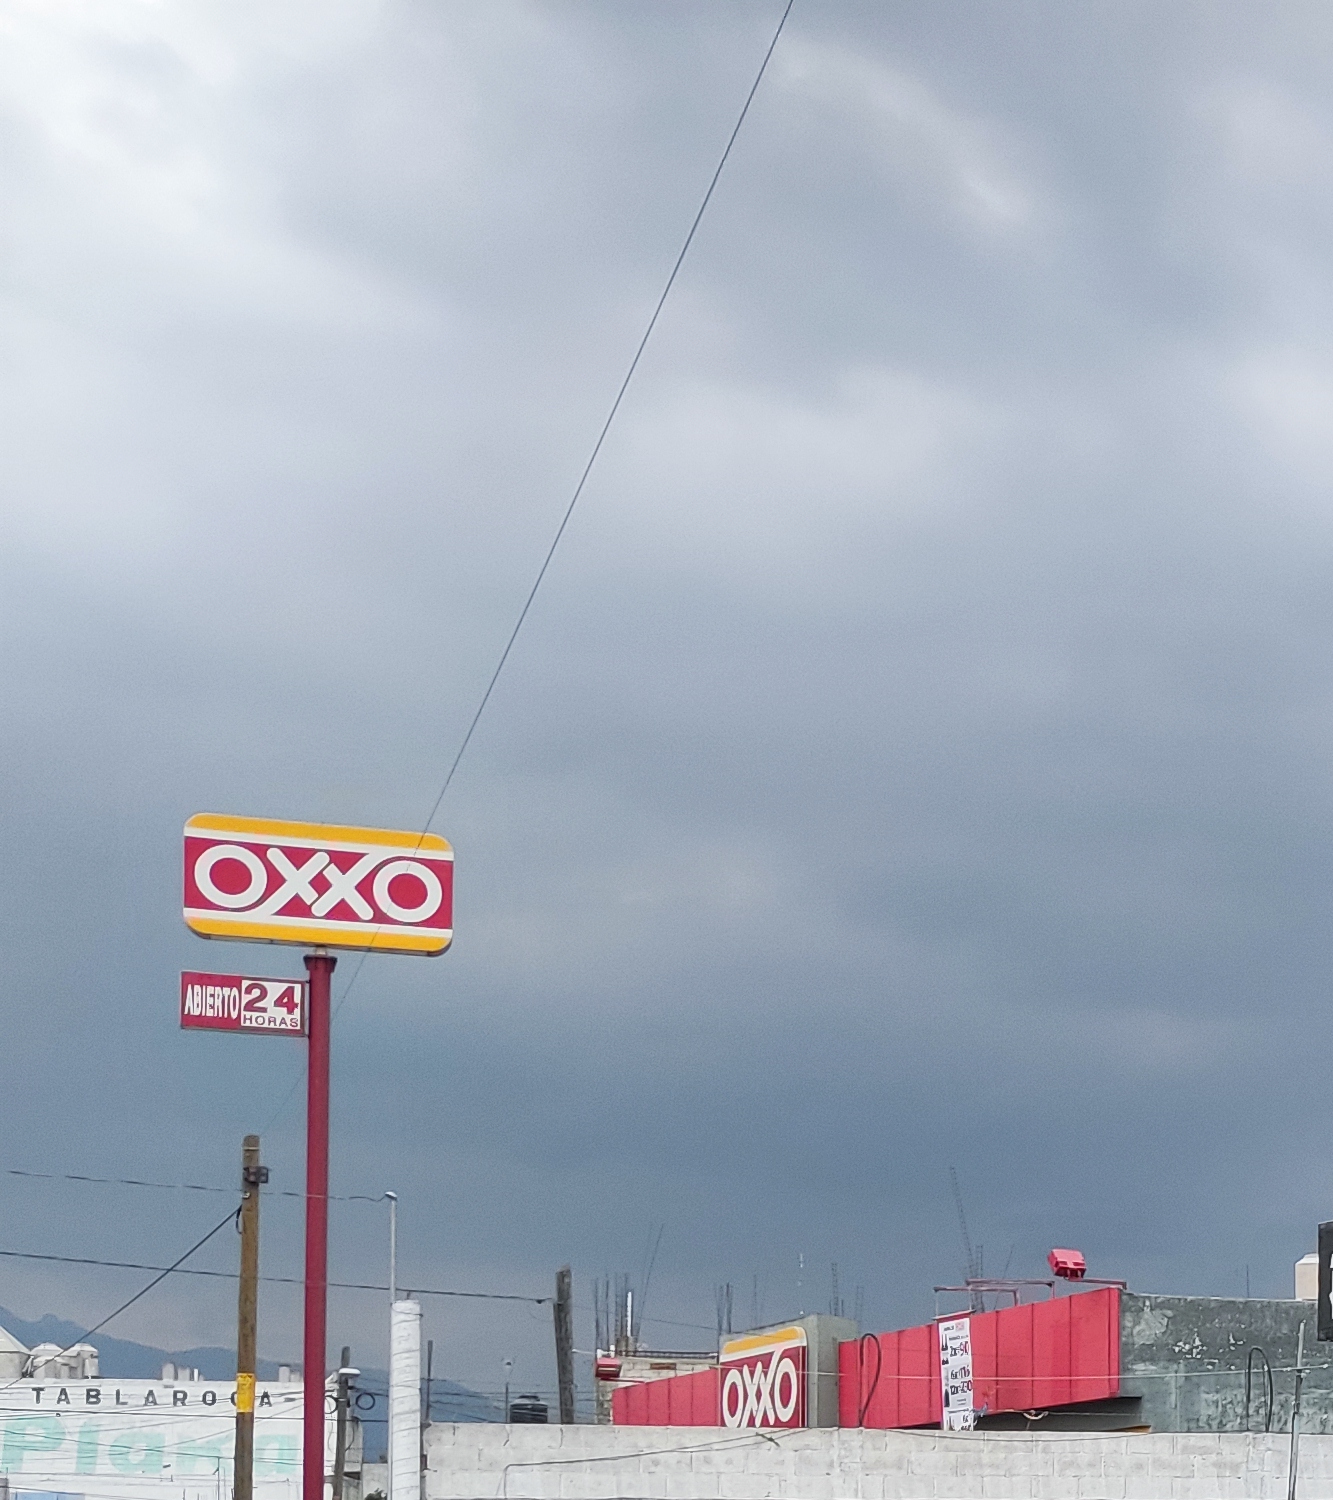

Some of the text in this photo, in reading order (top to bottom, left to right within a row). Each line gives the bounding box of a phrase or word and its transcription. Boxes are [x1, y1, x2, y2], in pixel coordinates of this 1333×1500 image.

[194, 845, 443, 923] OXXO
[184, 982, 299, 1019] ABIERTO 24
[242, 1014, 299, 1028] HORAS
[723, 1357, 798, 1429] OXXO
